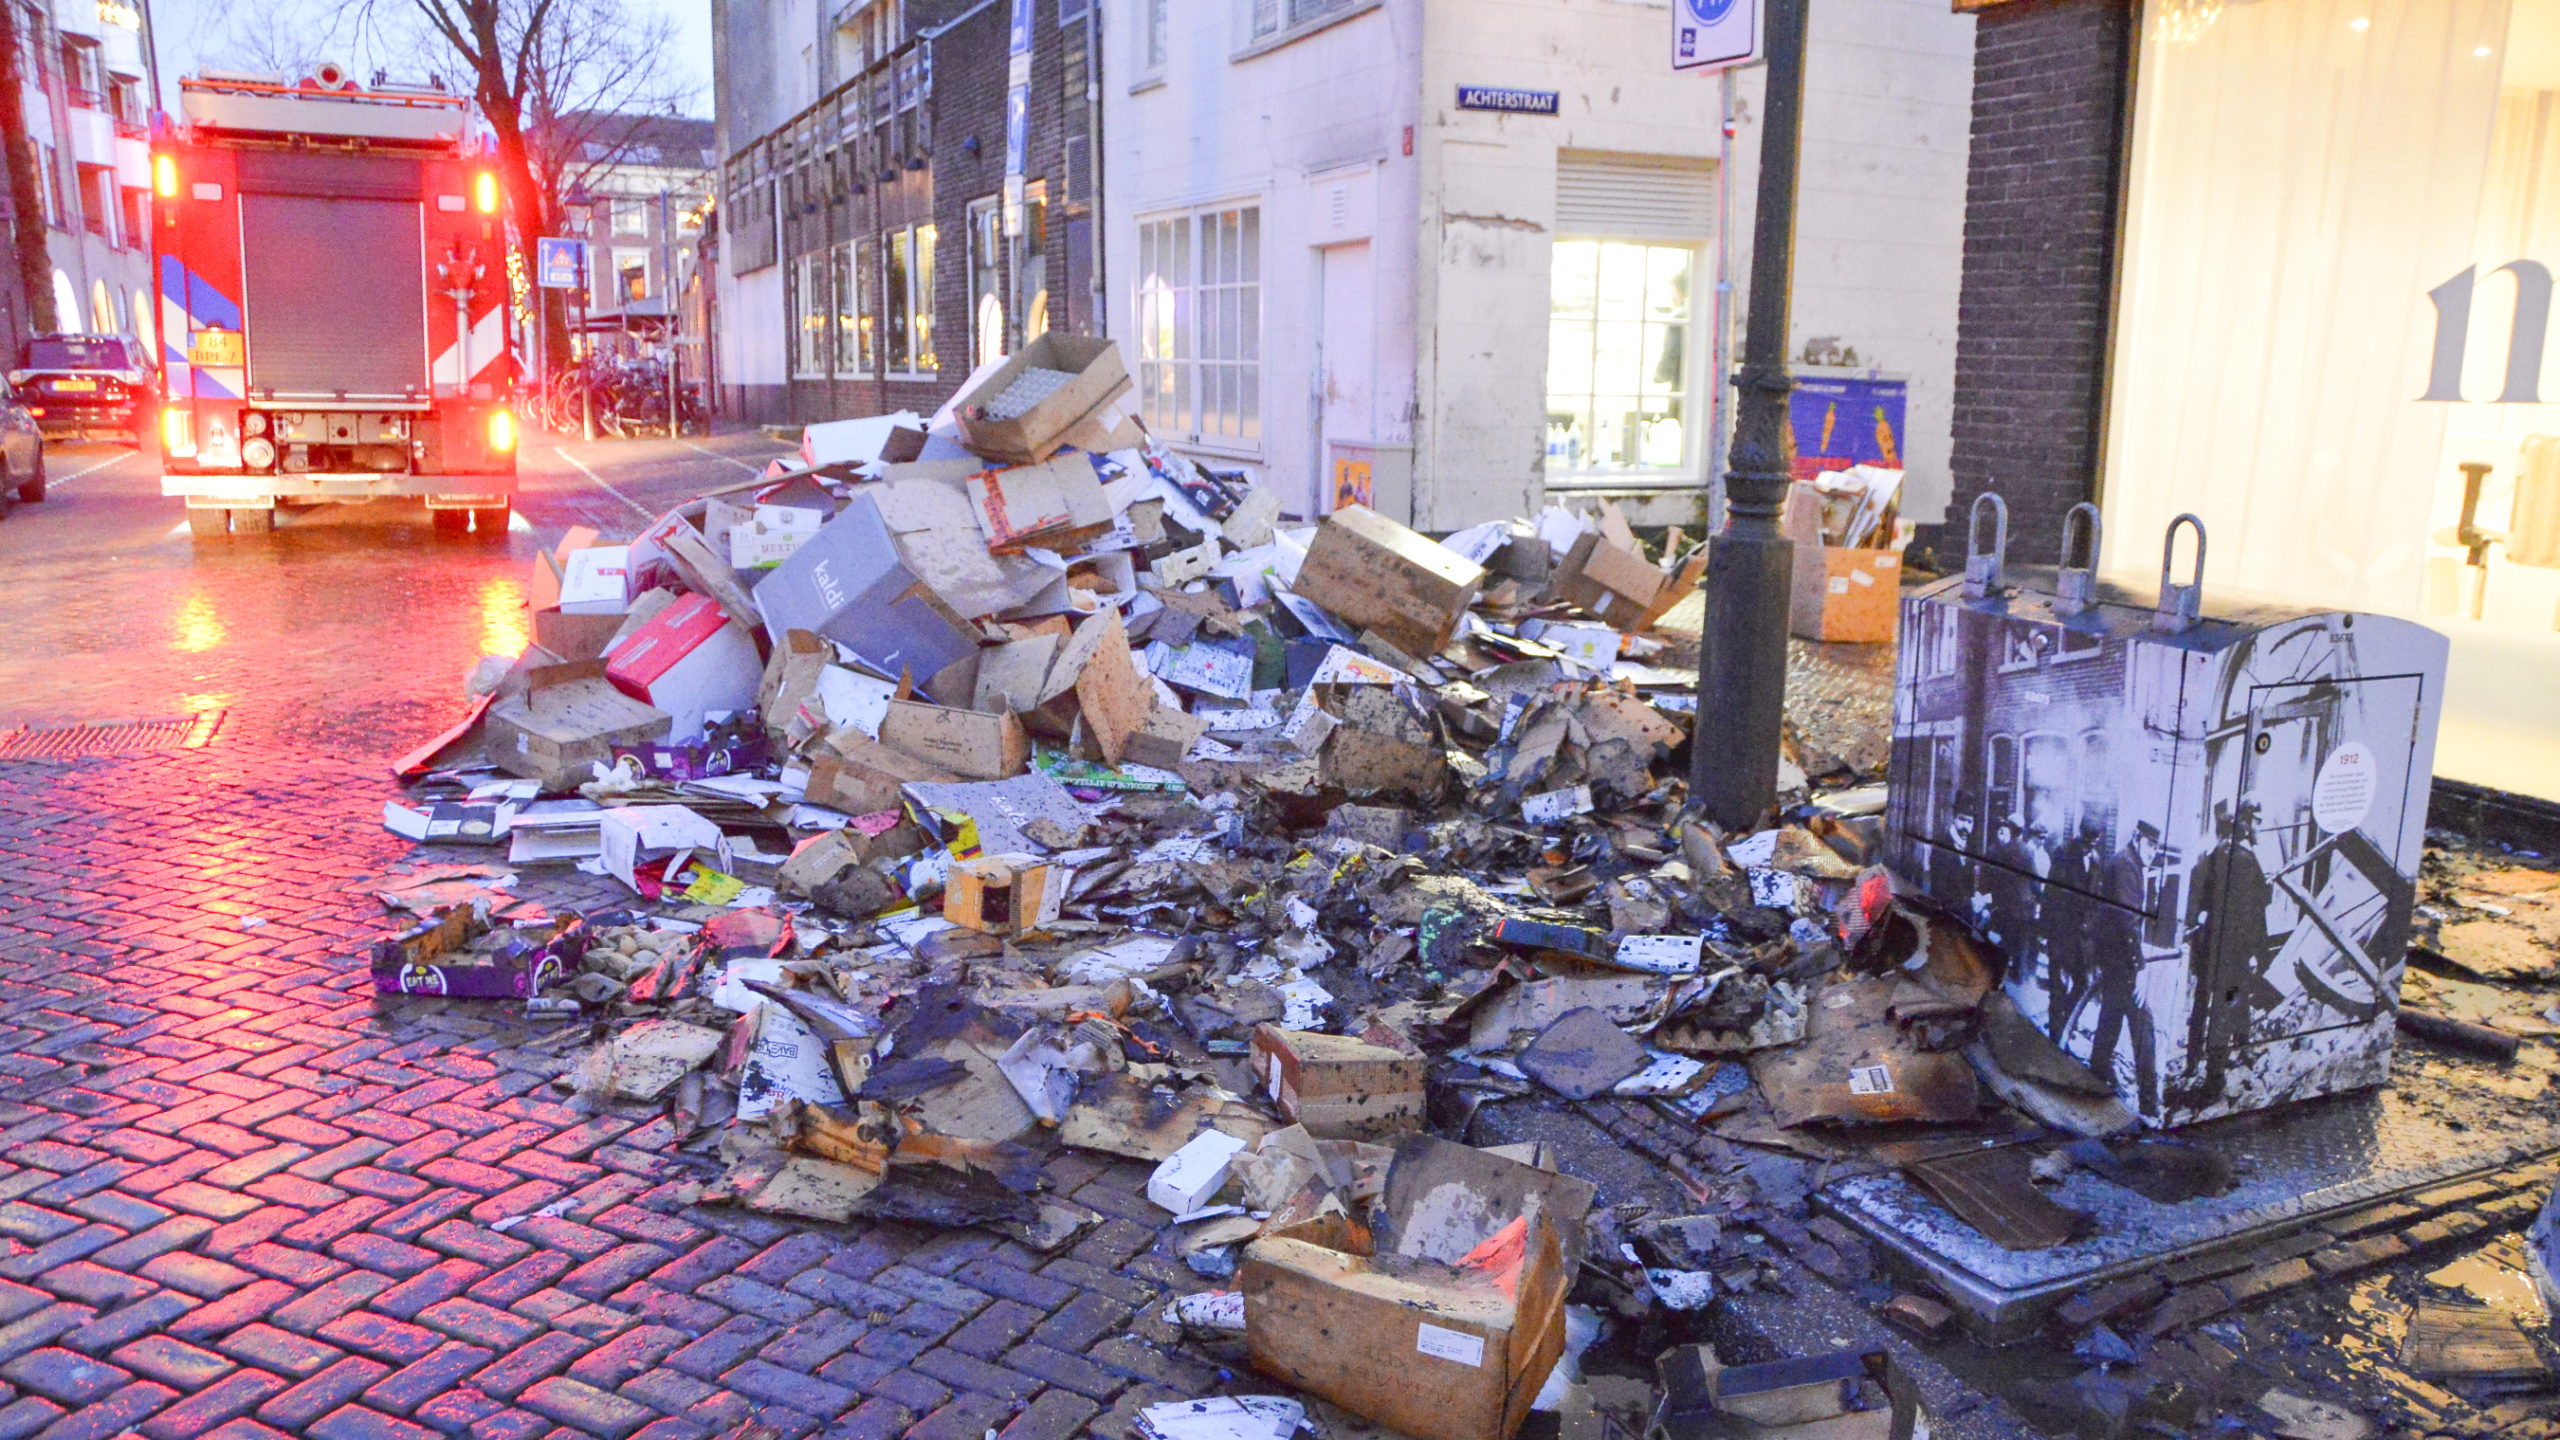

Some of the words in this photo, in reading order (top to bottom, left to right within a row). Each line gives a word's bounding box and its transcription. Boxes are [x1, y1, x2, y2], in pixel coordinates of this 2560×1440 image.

[1464, 90, 1554, 112] ACHTERSTRAAT
[209, 336, 228, 348] 84
[814, 558, 844, 610] kaldi
[2340, 753, 2359, 765] 1912
[406, 974, 423, 988] EAT
[423, 973, 440, 986] ME
